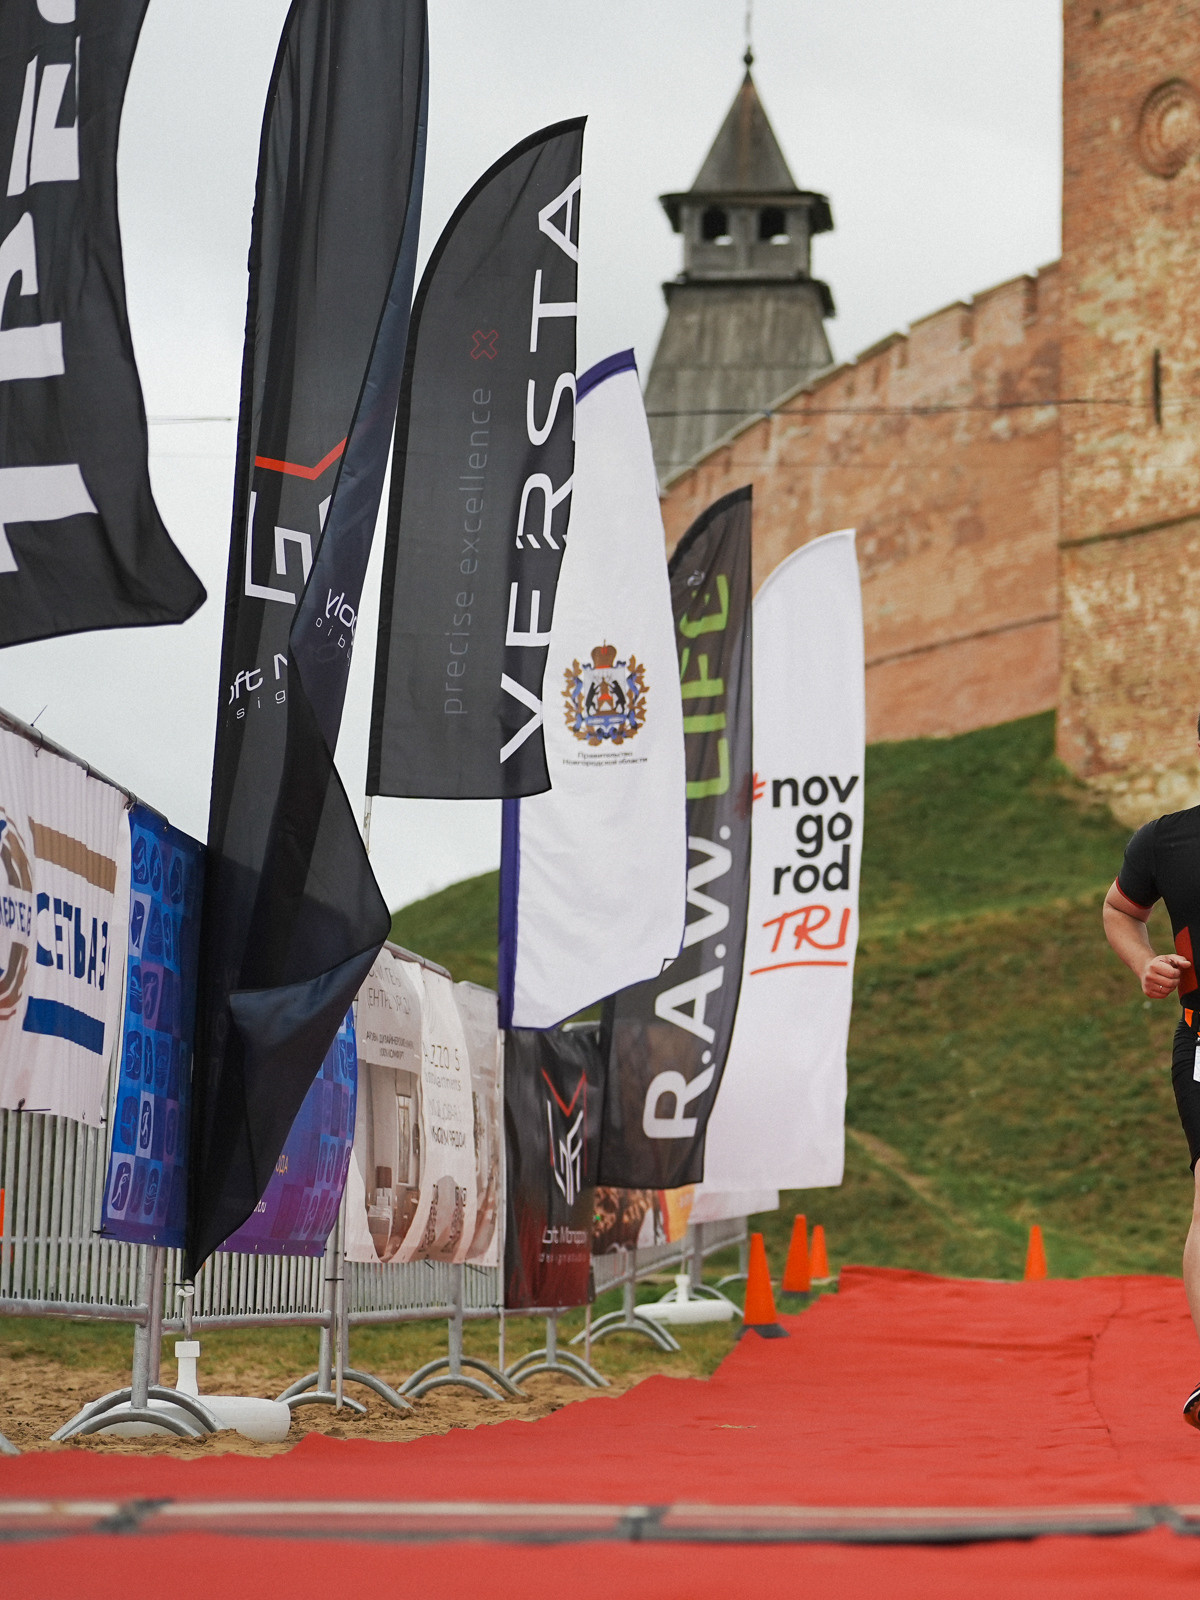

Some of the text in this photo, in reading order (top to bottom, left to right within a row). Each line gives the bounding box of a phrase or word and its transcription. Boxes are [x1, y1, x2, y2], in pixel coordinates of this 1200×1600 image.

[499, 174, 582, 764] VERSTA
[444, 387, 492, 718] precise excellence
[796, 811, 853, 858] go
[773, 844, 851, 895] rod
[762, 904, 851, 953] TRI
